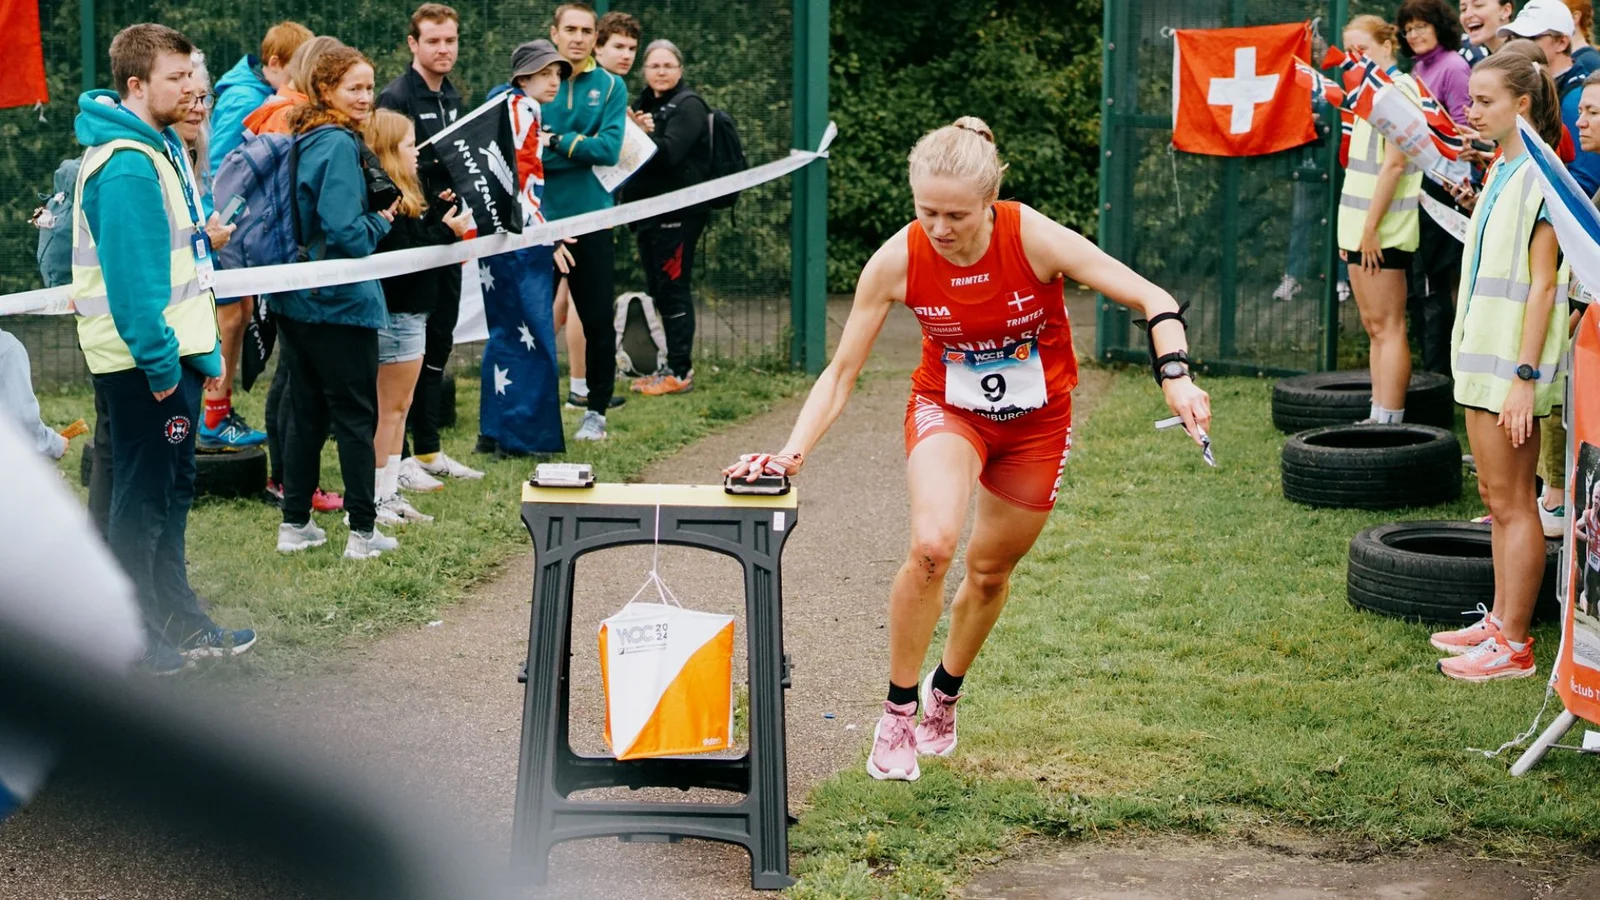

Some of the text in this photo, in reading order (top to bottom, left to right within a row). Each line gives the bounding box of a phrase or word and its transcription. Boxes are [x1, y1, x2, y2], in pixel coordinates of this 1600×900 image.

[950, 273, 990, 287] TRIMTEX
[914, 306, 951, 316] SILVA
[1006, 307, 1044, 327] TRIMTEX
[973, 353, 996, 361] WOC
[981, 374, 1006, 402] 9
[616, 623, 668, 645] WOC 20
[656, 632, 668, 640] 24
